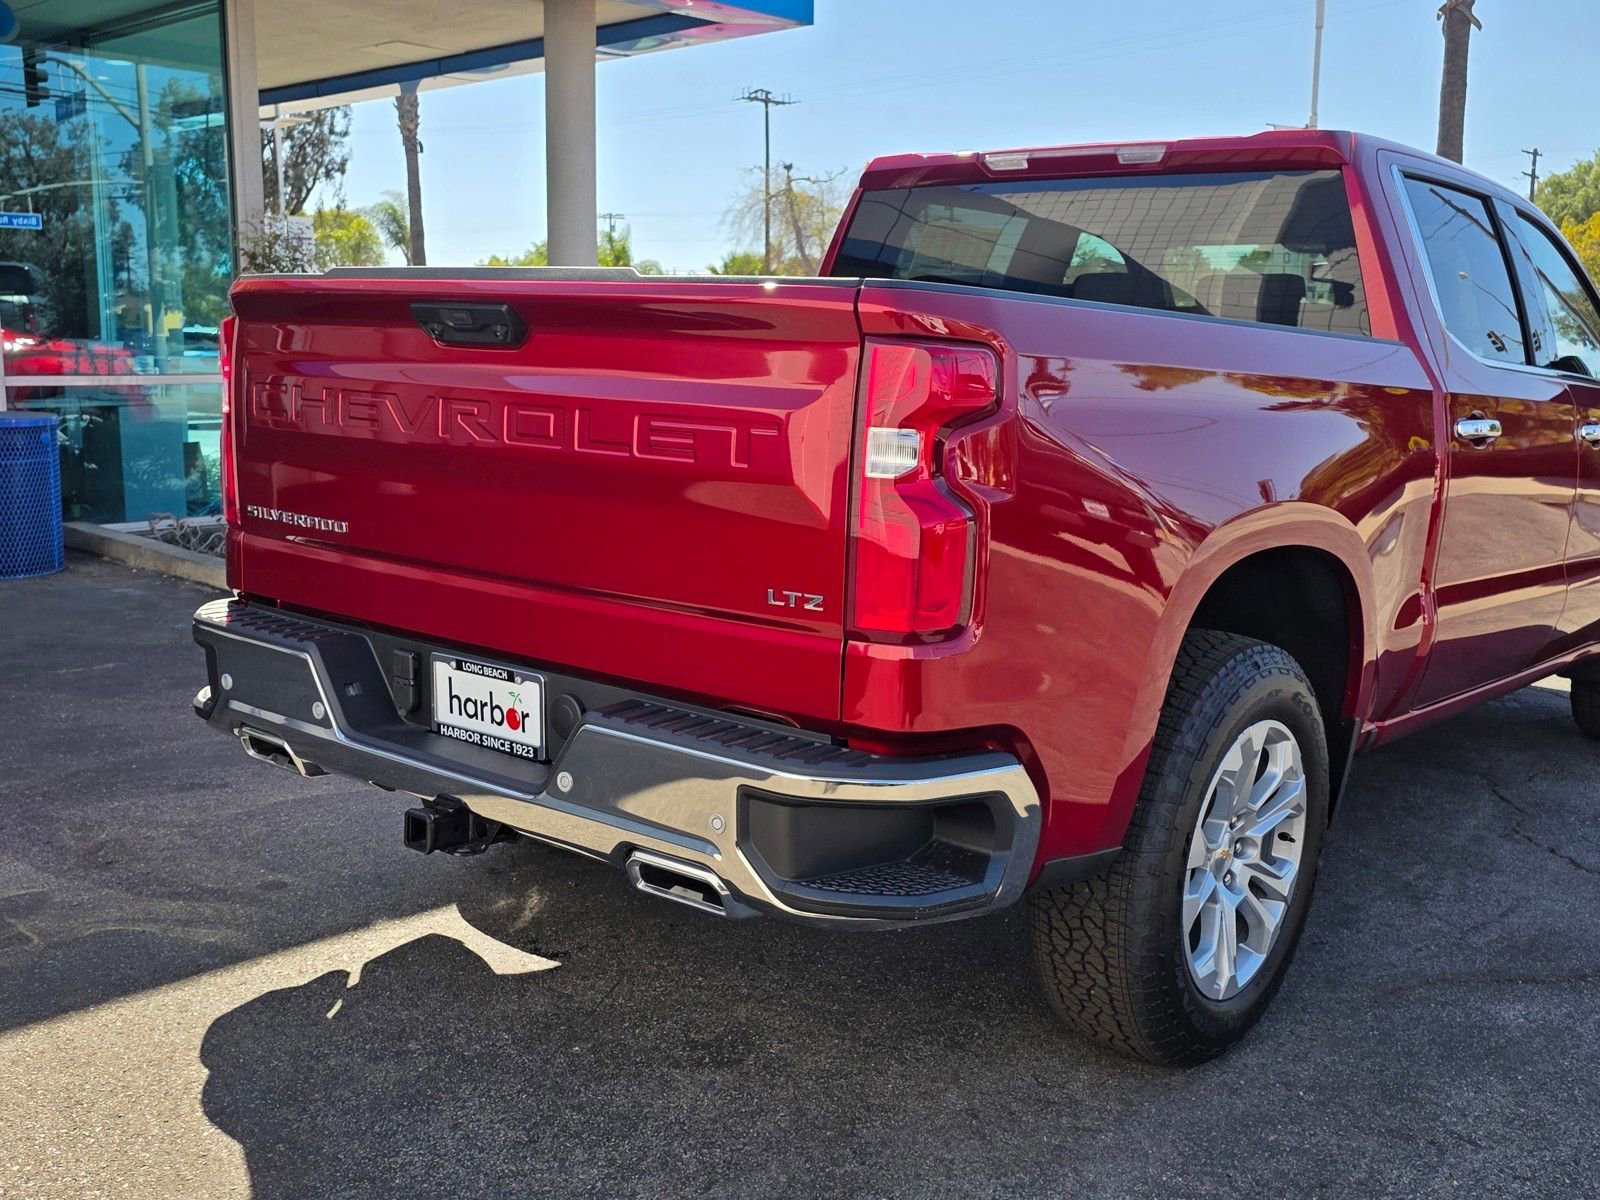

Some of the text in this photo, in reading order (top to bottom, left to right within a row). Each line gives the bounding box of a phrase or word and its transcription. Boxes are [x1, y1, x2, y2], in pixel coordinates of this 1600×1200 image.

[252, 375, 780, 469] CHEVROLET
[247, 504, 349, 533] SILVERADO
[767, 588, 824, 611] LTZ
[462, 661, 508, 680] LONG BEACH
[448, 676, 530, 733] harbor
[440, 724, 534, 758] HARBOR SINCE 1923
